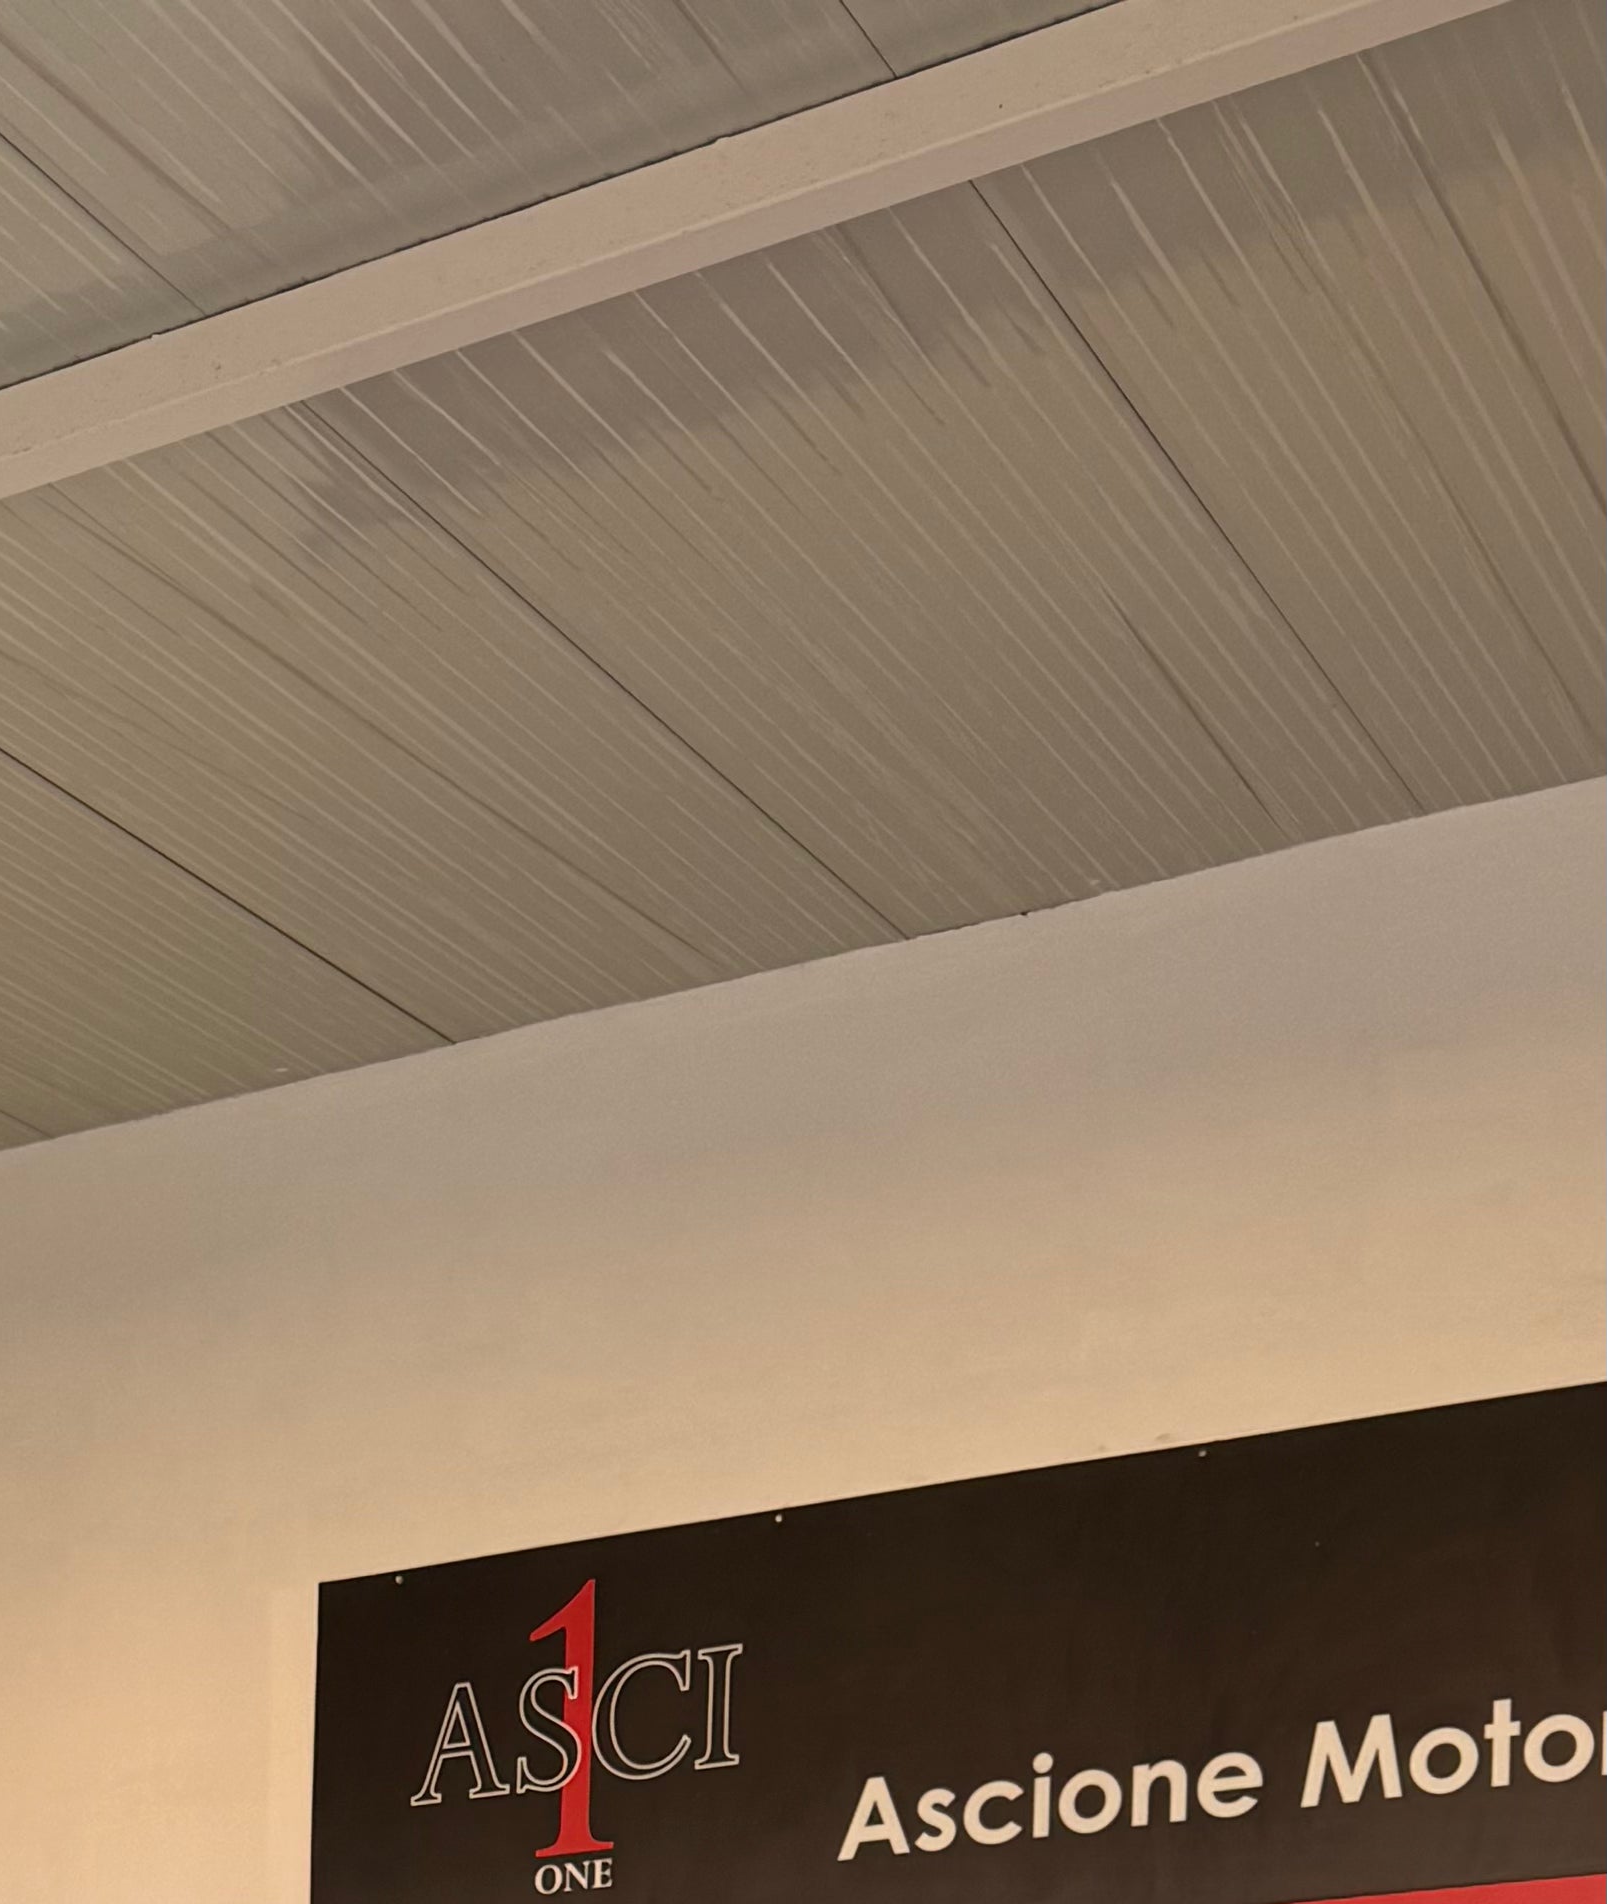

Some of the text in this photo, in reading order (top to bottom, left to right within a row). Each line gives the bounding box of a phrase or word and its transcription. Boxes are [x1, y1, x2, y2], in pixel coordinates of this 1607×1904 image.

[410, 1643, 744, 1807] ASCI
[837, 1752, 1264, 1862] Ascione
[534, 1857, 613, 1895] ONE
